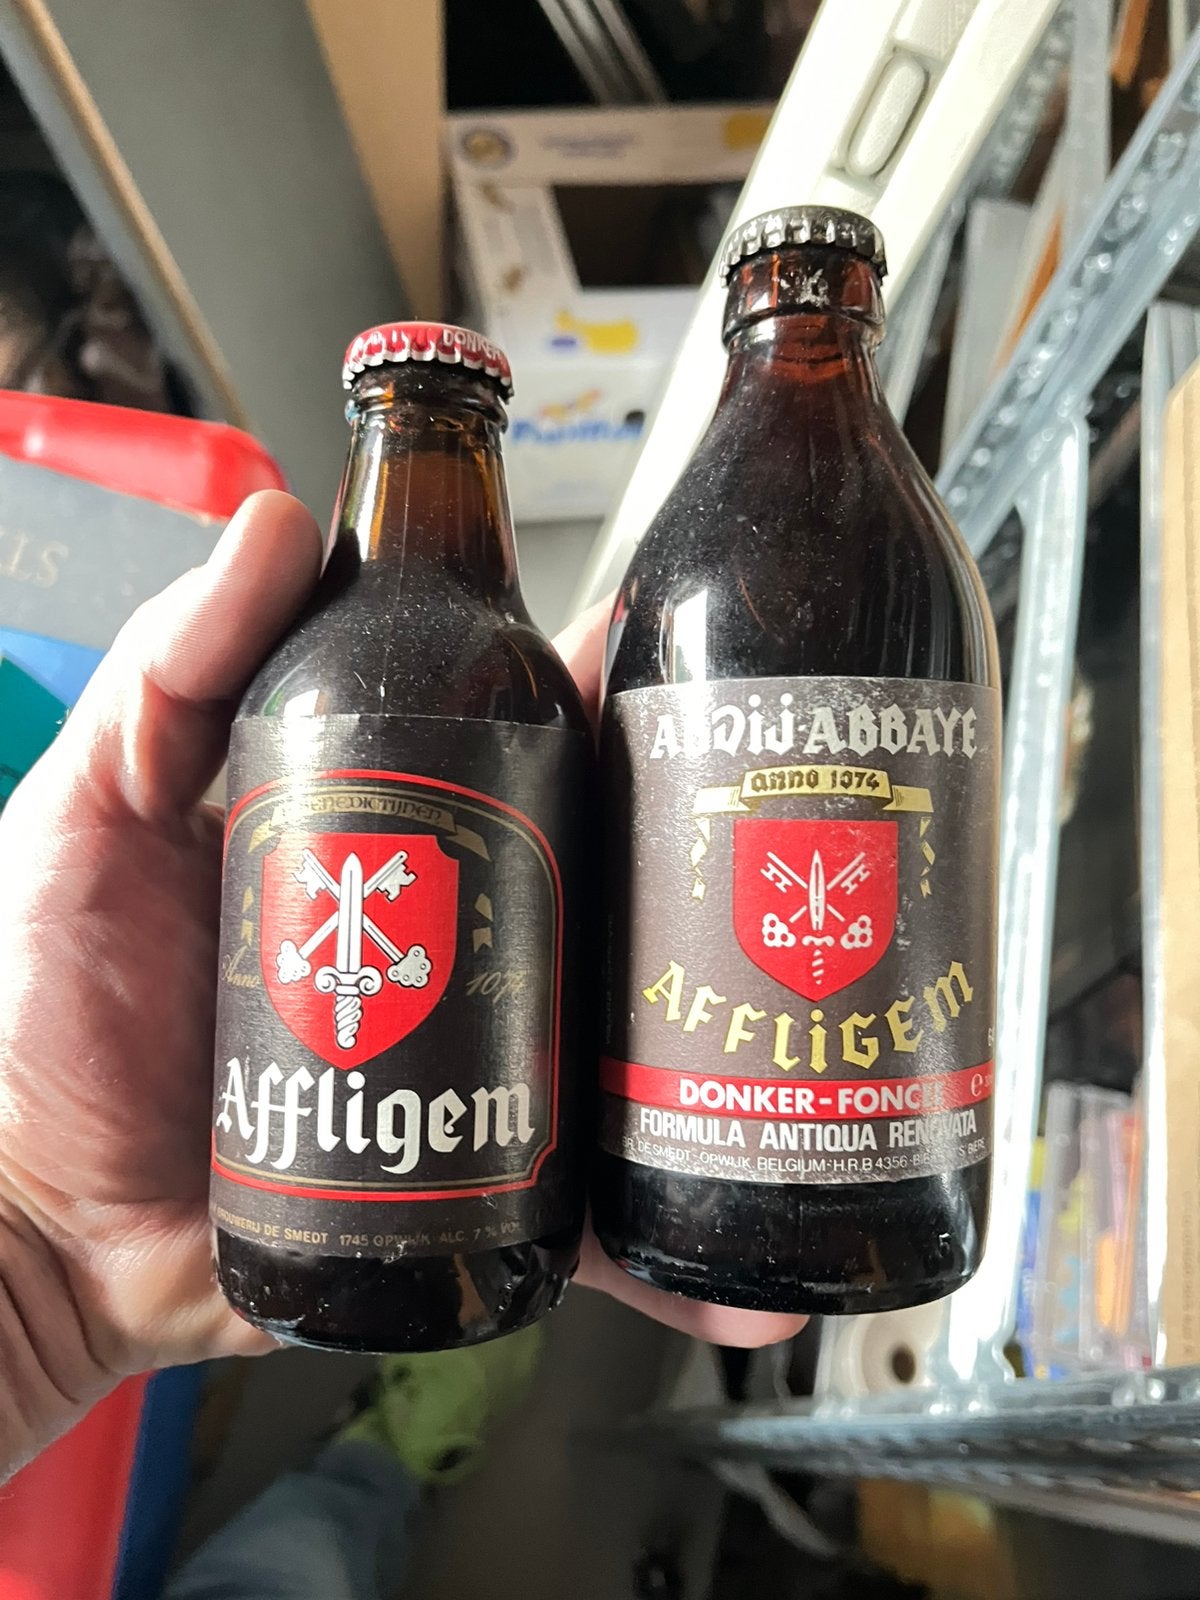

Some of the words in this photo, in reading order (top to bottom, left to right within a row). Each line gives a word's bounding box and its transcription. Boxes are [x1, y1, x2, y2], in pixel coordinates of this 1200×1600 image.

[831, 769, 880, 791] 1074
[216, 1057, 536, 1174] Affligem
[640, 1107, 746, 1148] FORMULA
[759, 1122, 878, 1152] ANTIQUA
[875, 1153, 908, 1170] 4356
[264, 1225, 281, 1238] DE
[284, 1227, 329, 1244] SMEDT
[339, 1233, 369, 1247] 1745
[473, 1228, 481, 1240] 7
